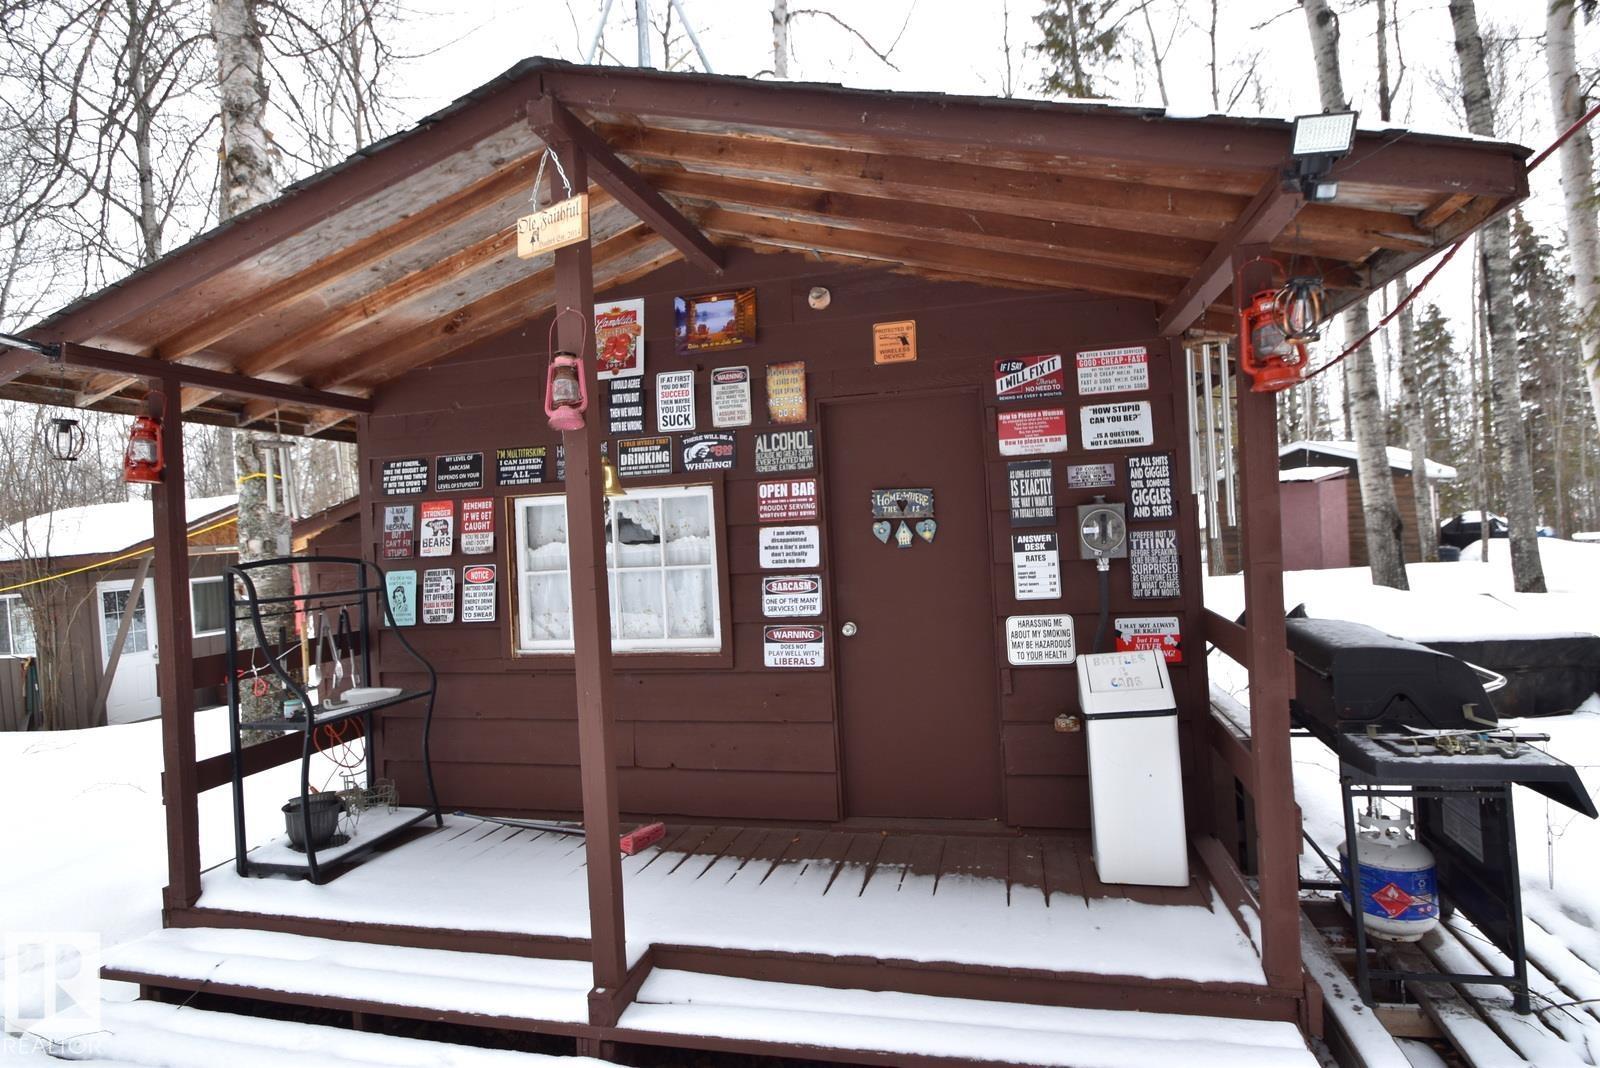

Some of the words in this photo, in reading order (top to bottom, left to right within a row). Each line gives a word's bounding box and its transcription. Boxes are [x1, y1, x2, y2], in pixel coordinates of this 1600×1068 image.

[1101, 357, 1123, 365] CHEAP
[1000, 363, 1007, 371] IF
[1011, 362, 1023, 370] SAY
[1006, 372, 1028, 388] WILL
[1030, 363, 1044, 378] FIX
[1048, 359, 1056, 371] IT
[661, 390, 689, 398] SUCCEED
[610, 408, 620, 418] THEN
[621, 408, 627, 417] WE
[1113, 404, 1140, 413] STUPID
[662, 414, 691, 426] SUCK
[683, 435, 703, 444] THERE
[756, 431, 813, 452] ALCOHOL
[1109, 437, 1144, 445] CHALLENGE!
[507, 447, 545, 458] MULTITASKING
[621, 451, 669, 465] DRINKING
[1129, 458, 1139, 467] IT'S
[1141, 457, 1151, 466] ALL
[1152, 456, 1168, 465] SHITS
[685, 461, 731, 471] WHINING!
[1131, 468, 1143, 479] AND
[1145, 466, 1169, 478] GIGGLES
[1011, 480, 1018, 496] IS
[1020, 478, 1051, 496] EXACTLY
[1131, 480, 1144, 488] UNTIL
[1147, 479, 1170, 487] SOMEONE
[760, 483, 787, 498] OPEN
[792, 482, 814, 496] BAR
[1132, 488, 1171, 505] GIGGLES
[464, 501, 492, 510] REMEMBER
[1134, 506, 1150, 518] AND
[1152, 505, 1172, 517] SHITS
[465, 522, 490, 530] CAUGHT
[1018, 535, 1051, 543] ANSWER
[1168, 530, 1175, 538] TO
[423, 537, 450, 547] BEARS
[1131, 538, 1176, 549] THINK
[1132, 563, 1178, 574] SURPRISED
[471, 571, 489, 579] NOTICE
[772, 581, 811, 591] SARCASM
[1018, 619, 1051, 628] HARASSING
[1011, 631, 1030, 639] ABOUT
[1043, 629, 1070, 638] SMOKING
[1035, 640, 1071, 648] HAZARDOUS
[1027, 651, 1042, 660] YOUR
[1093, 654, 1145, 666] BOTTLES
